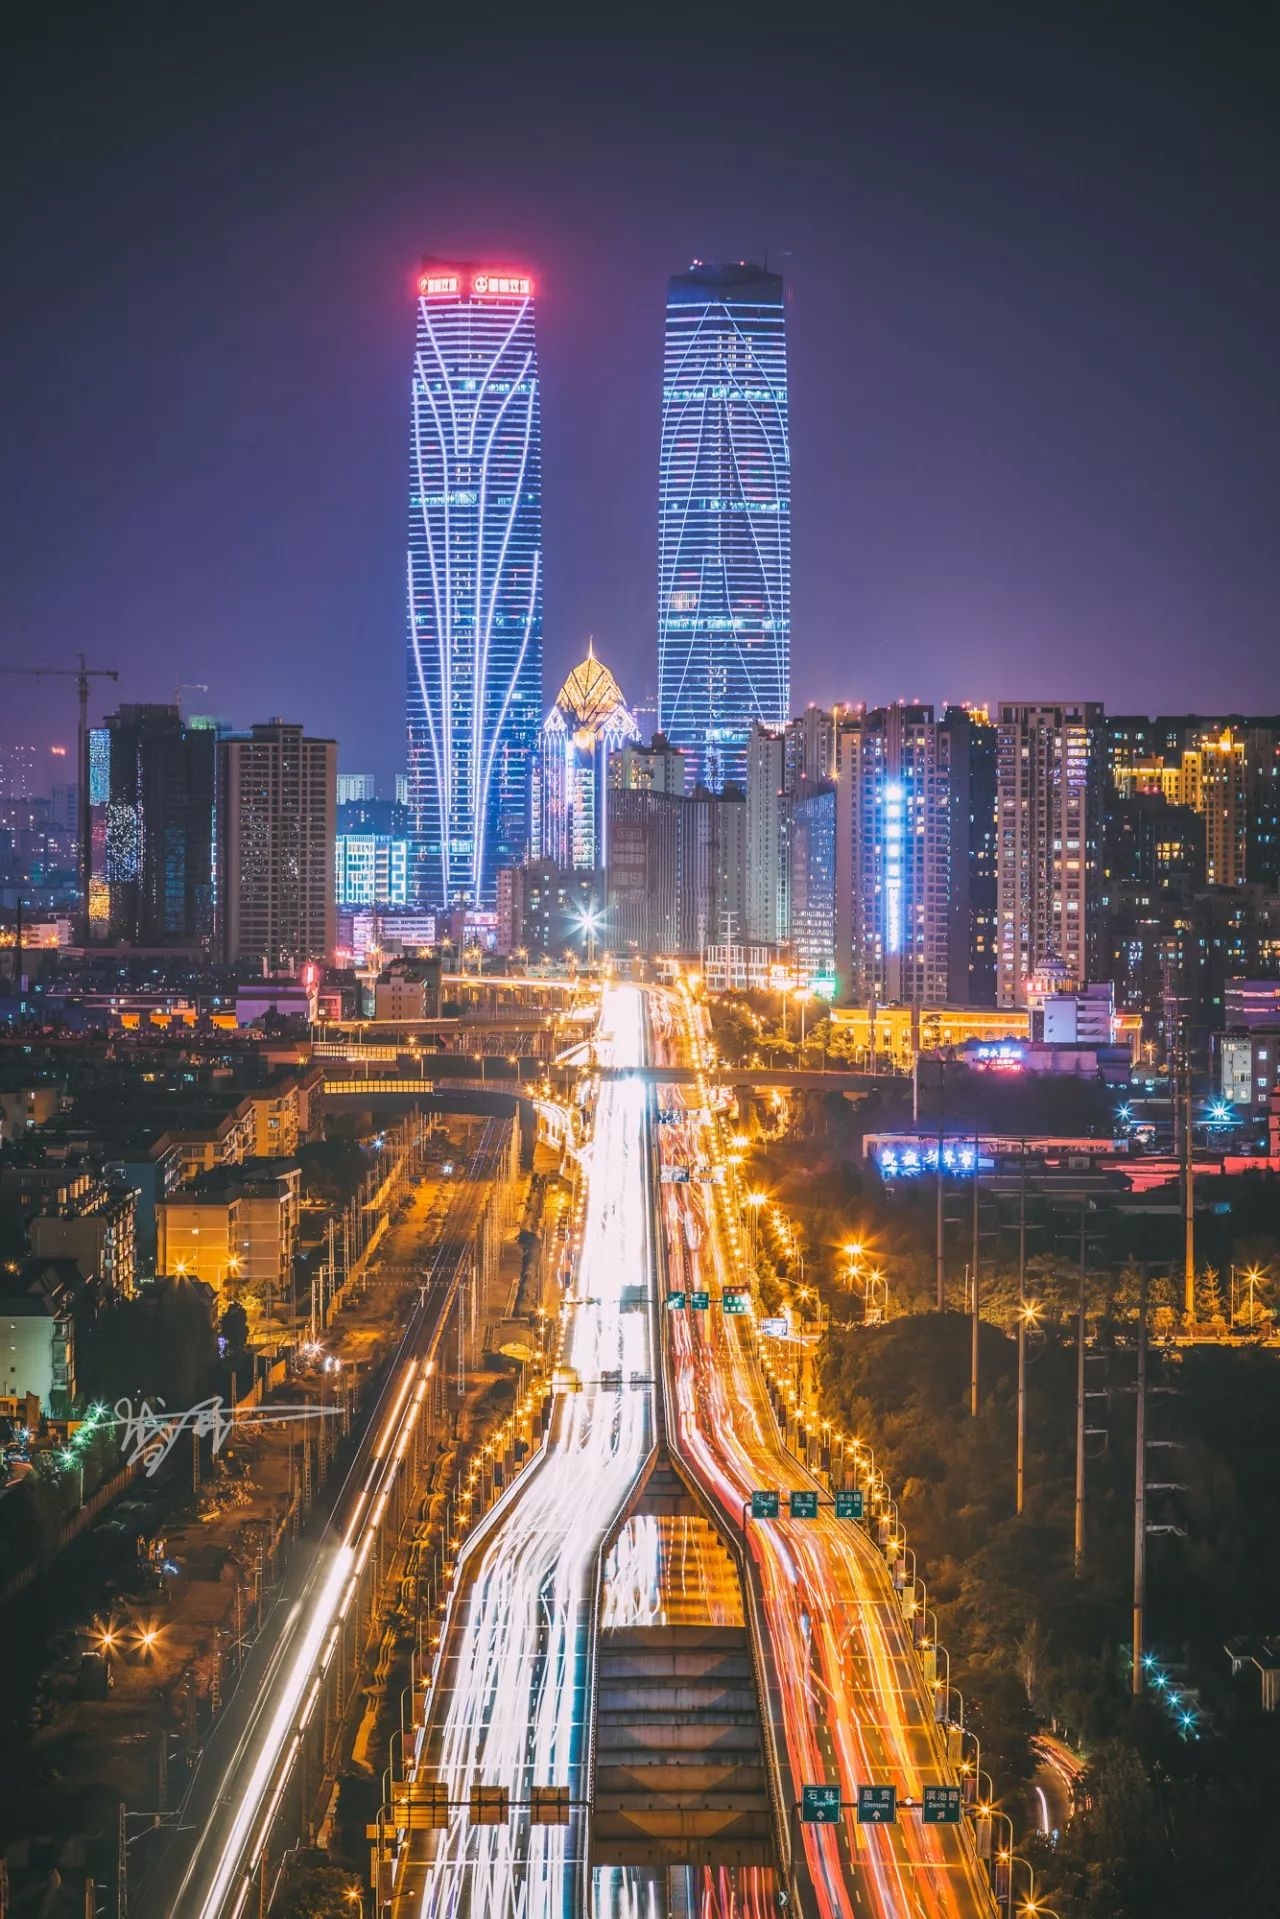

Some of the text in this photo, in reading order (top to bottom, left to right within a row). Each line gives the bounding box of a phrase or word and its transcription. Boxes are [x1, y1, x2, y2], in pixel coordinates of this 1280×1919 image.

[807, 1790, 836, 1801] 石林
[863, 1790, 891, 1801] 呈贡
[925, 1790, 959, 1802] 滇池路
